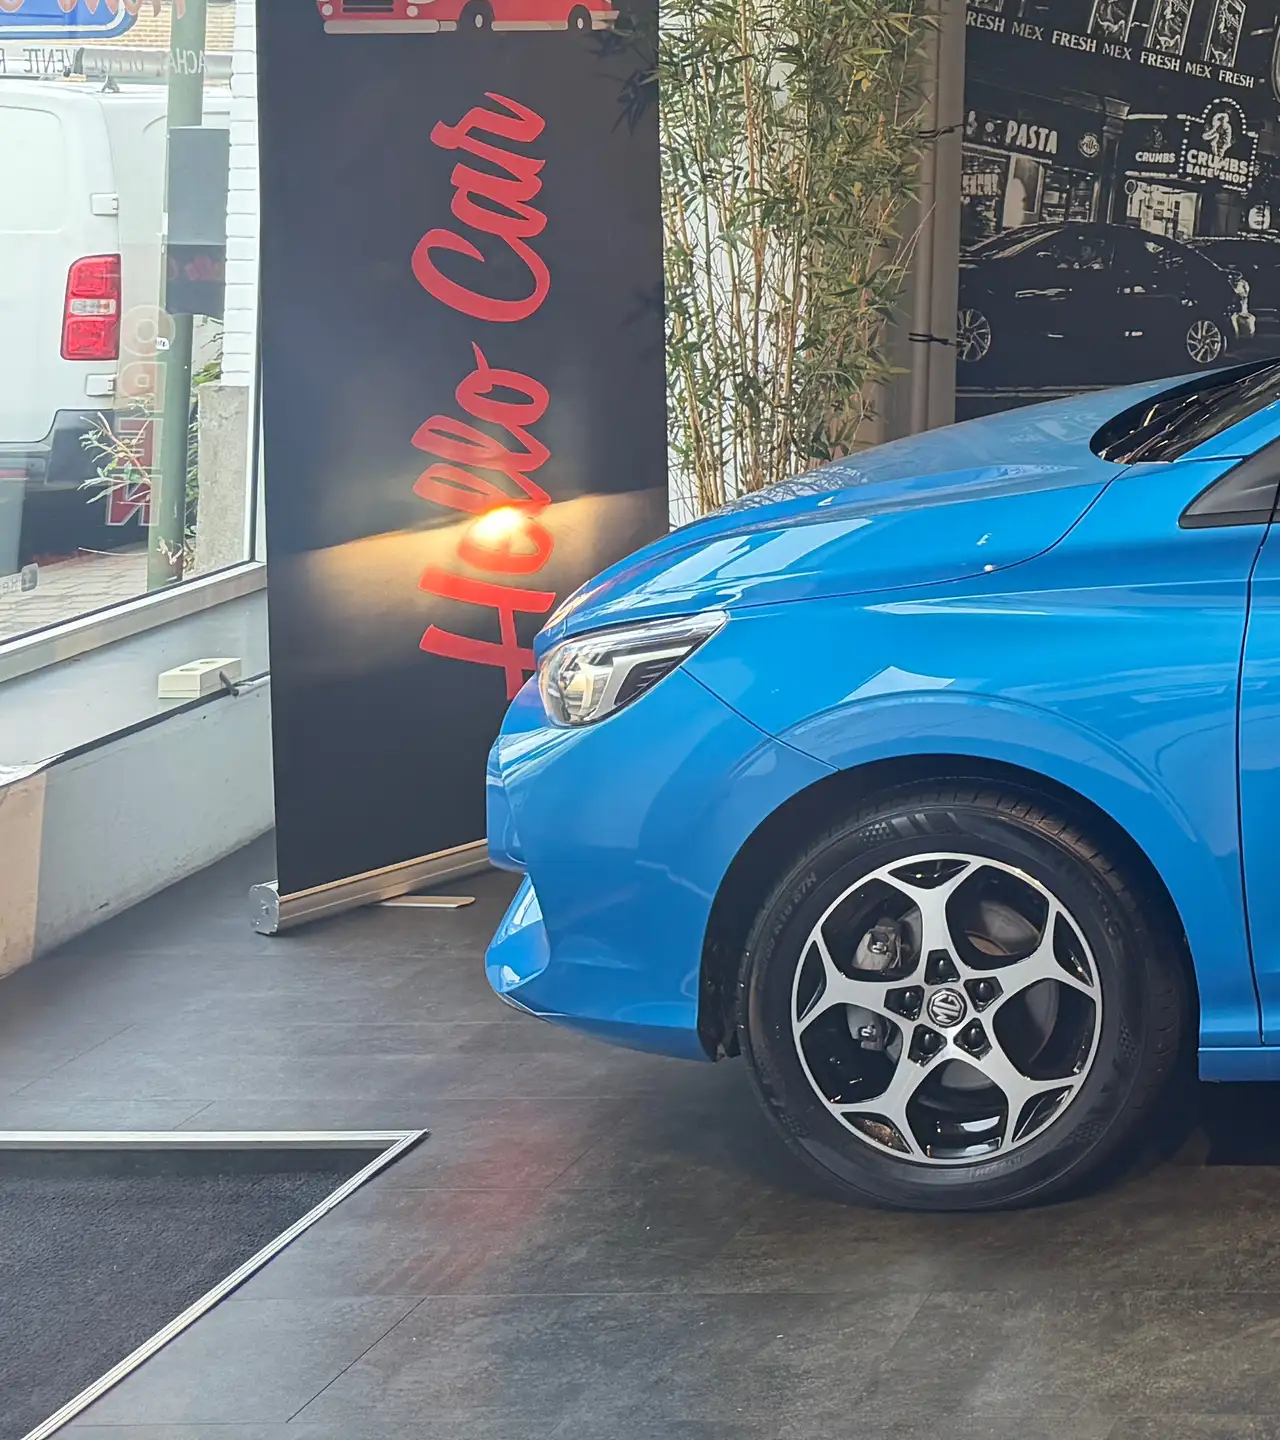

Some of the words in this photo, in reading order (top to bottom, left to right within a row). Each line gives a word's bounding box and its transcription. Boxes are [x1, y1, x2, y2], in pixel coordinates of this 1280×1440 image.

[966, 10, 1005, 34] RESH
[1011, 21, 1043, 42] MEX
[1051, 30, 1097, 53] FRESH
[1102, 42, 1132, 60] MEX
[1139, 51, 1181, 72] FRESH
[1185, 61, 1212, 79] MEX
[1218, 69, 1255, 89] FRESH
[1005, 120, 1058, 154] PASTA
[1135, 151, 1176, 164] CRUMBS
[1186, 149, 1249, 175] CRUMBS
[1186, 164, 1216, 178] BAKE
[1218, 171, 1247, 185] SHOP
[410, 91, 551, 323] Car
[411, 340, 557, 702] Hello
